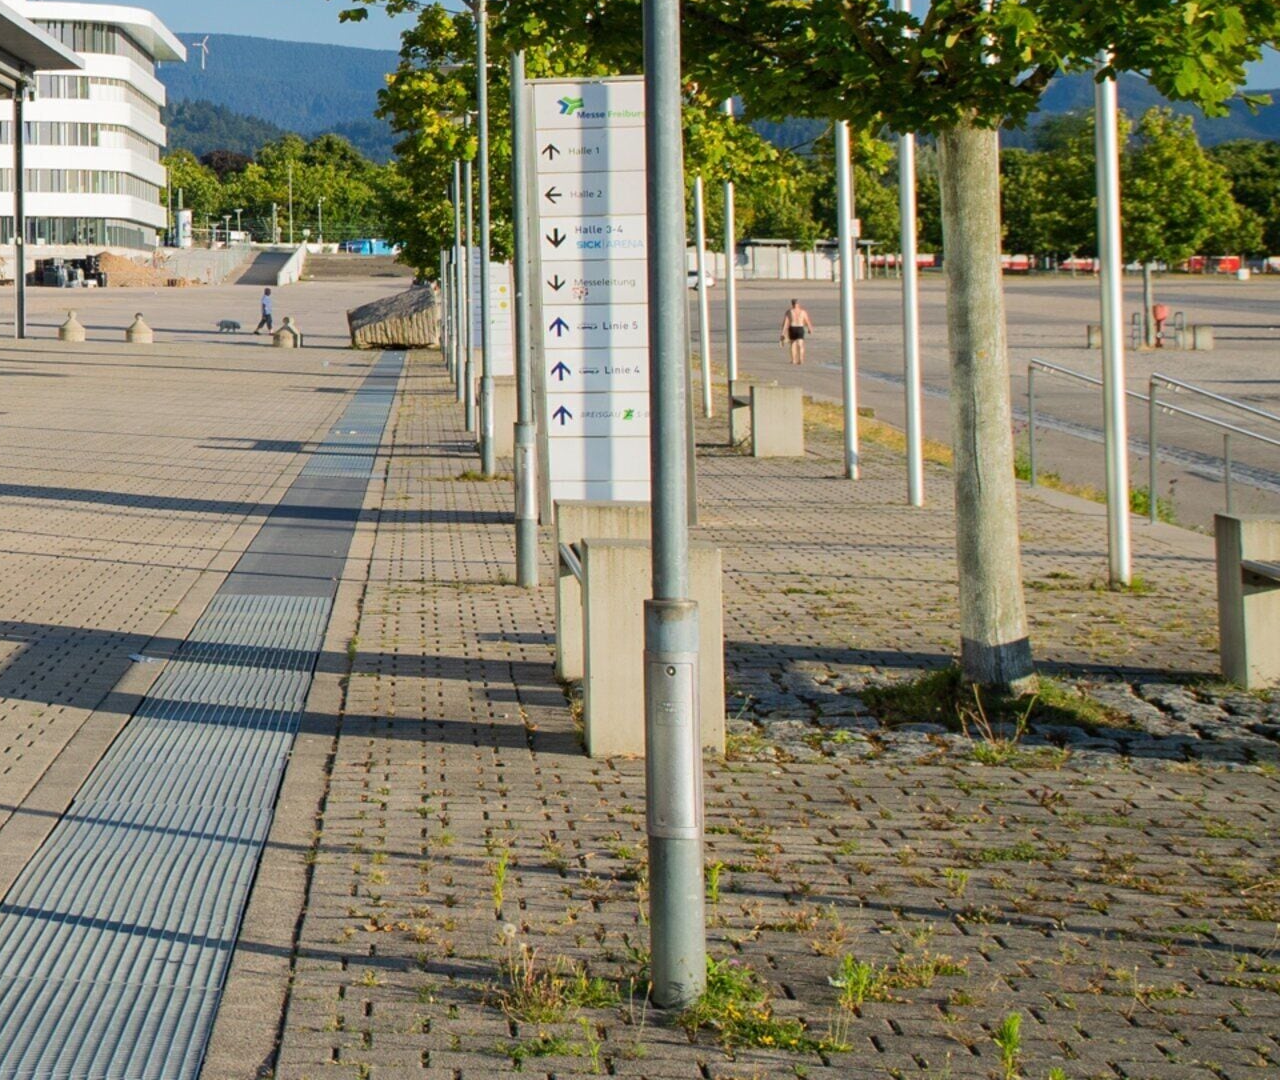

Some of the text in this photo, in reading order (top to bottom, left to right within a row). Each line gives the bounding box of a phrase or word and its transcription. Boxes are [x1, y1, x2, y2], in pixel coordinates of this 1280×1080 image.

[577, 111, 606, 119] Messe
[568, 147, 592, 155] Halle
[575, 225, 623, 234] Halle 3-4
[574, 278, 636, 287] Messeleitung
[602, 322, 629, 330] Linie
[604, 366, 630, 374] Linie
